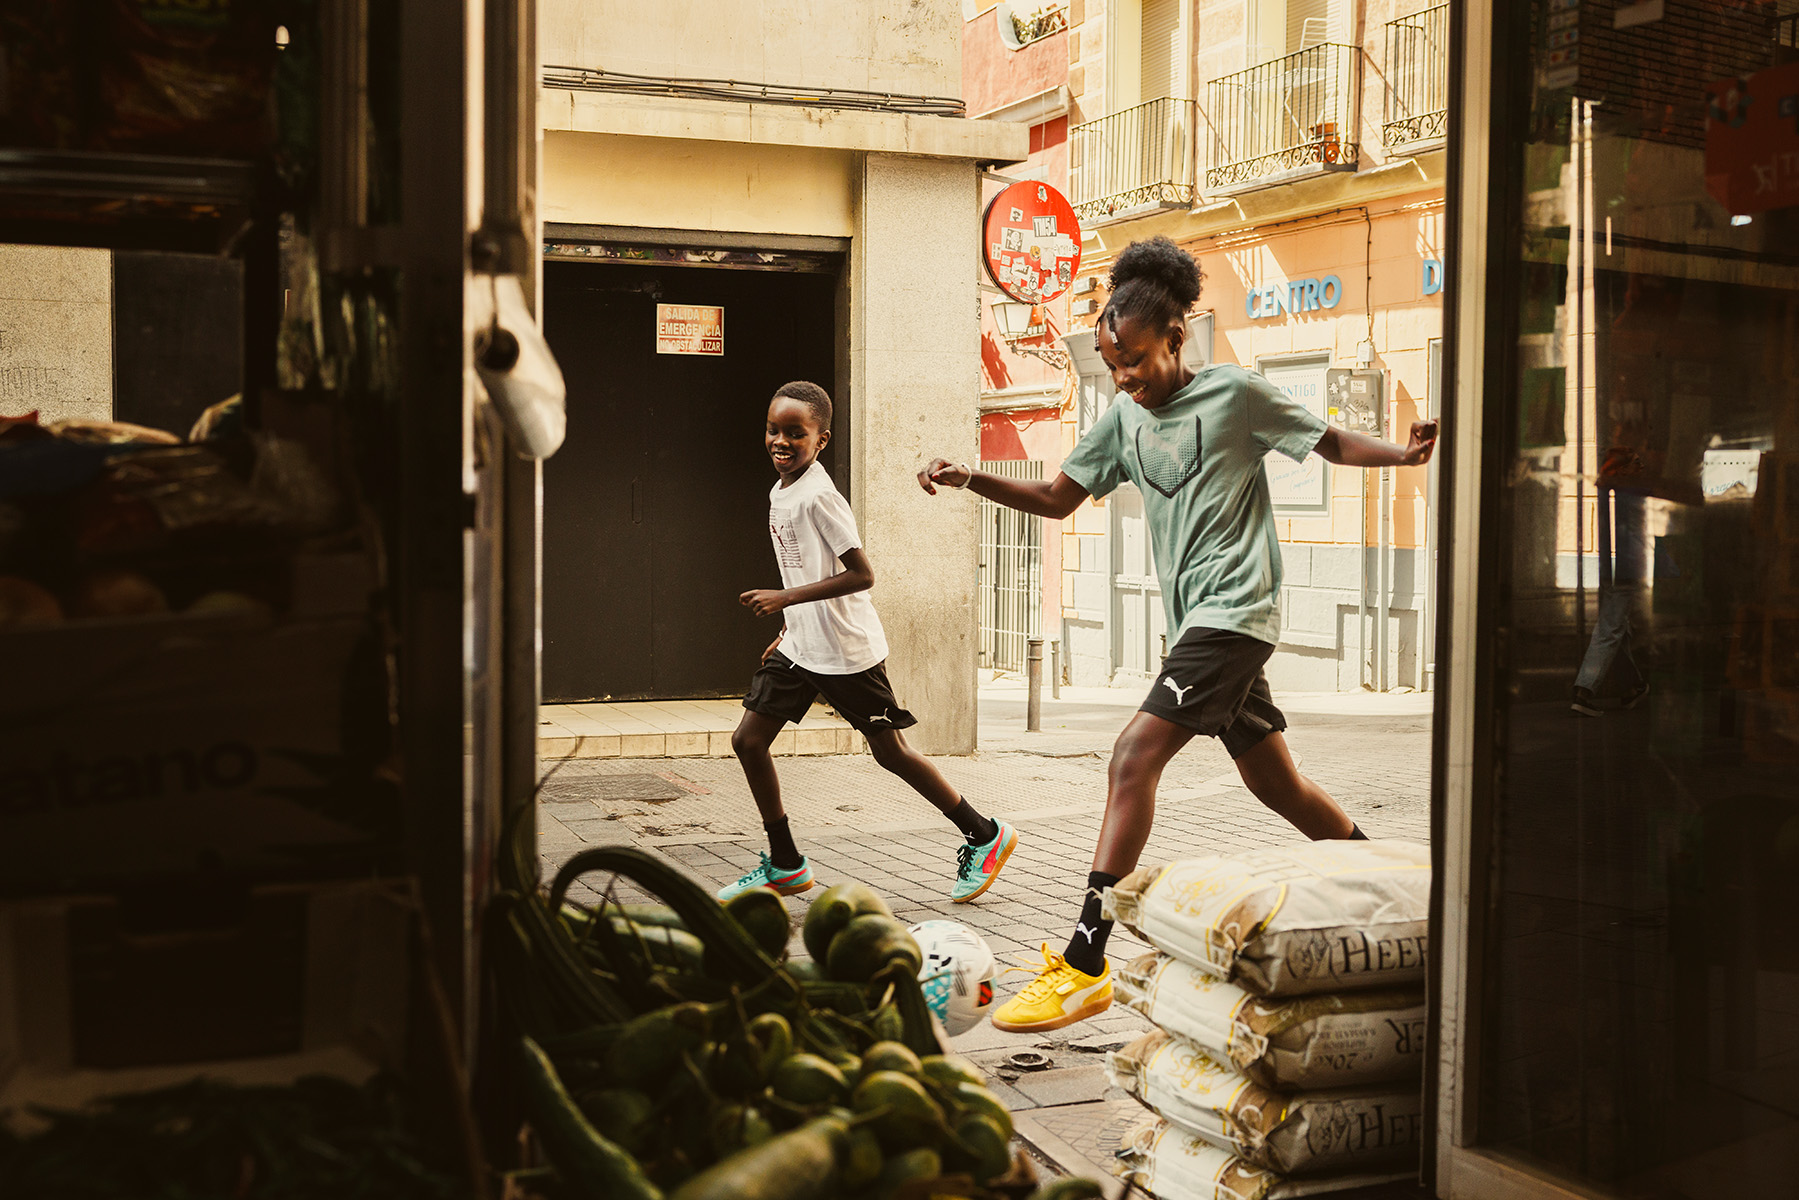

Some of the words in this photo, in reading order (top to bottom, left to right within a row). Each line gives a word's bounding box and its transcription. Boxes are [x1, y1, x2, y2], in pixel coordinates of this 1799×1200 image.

[1245, 275, 1342, 319] CENTRO
[1422, 256, 1444, 295] D
[666, 307, 700, 321] SALIDA
[702, 309, 715, 321] DE
[659, 322, 721, 337] EMERGENCIA
[671, 340, 721, 352] OBSTACULIZAR
